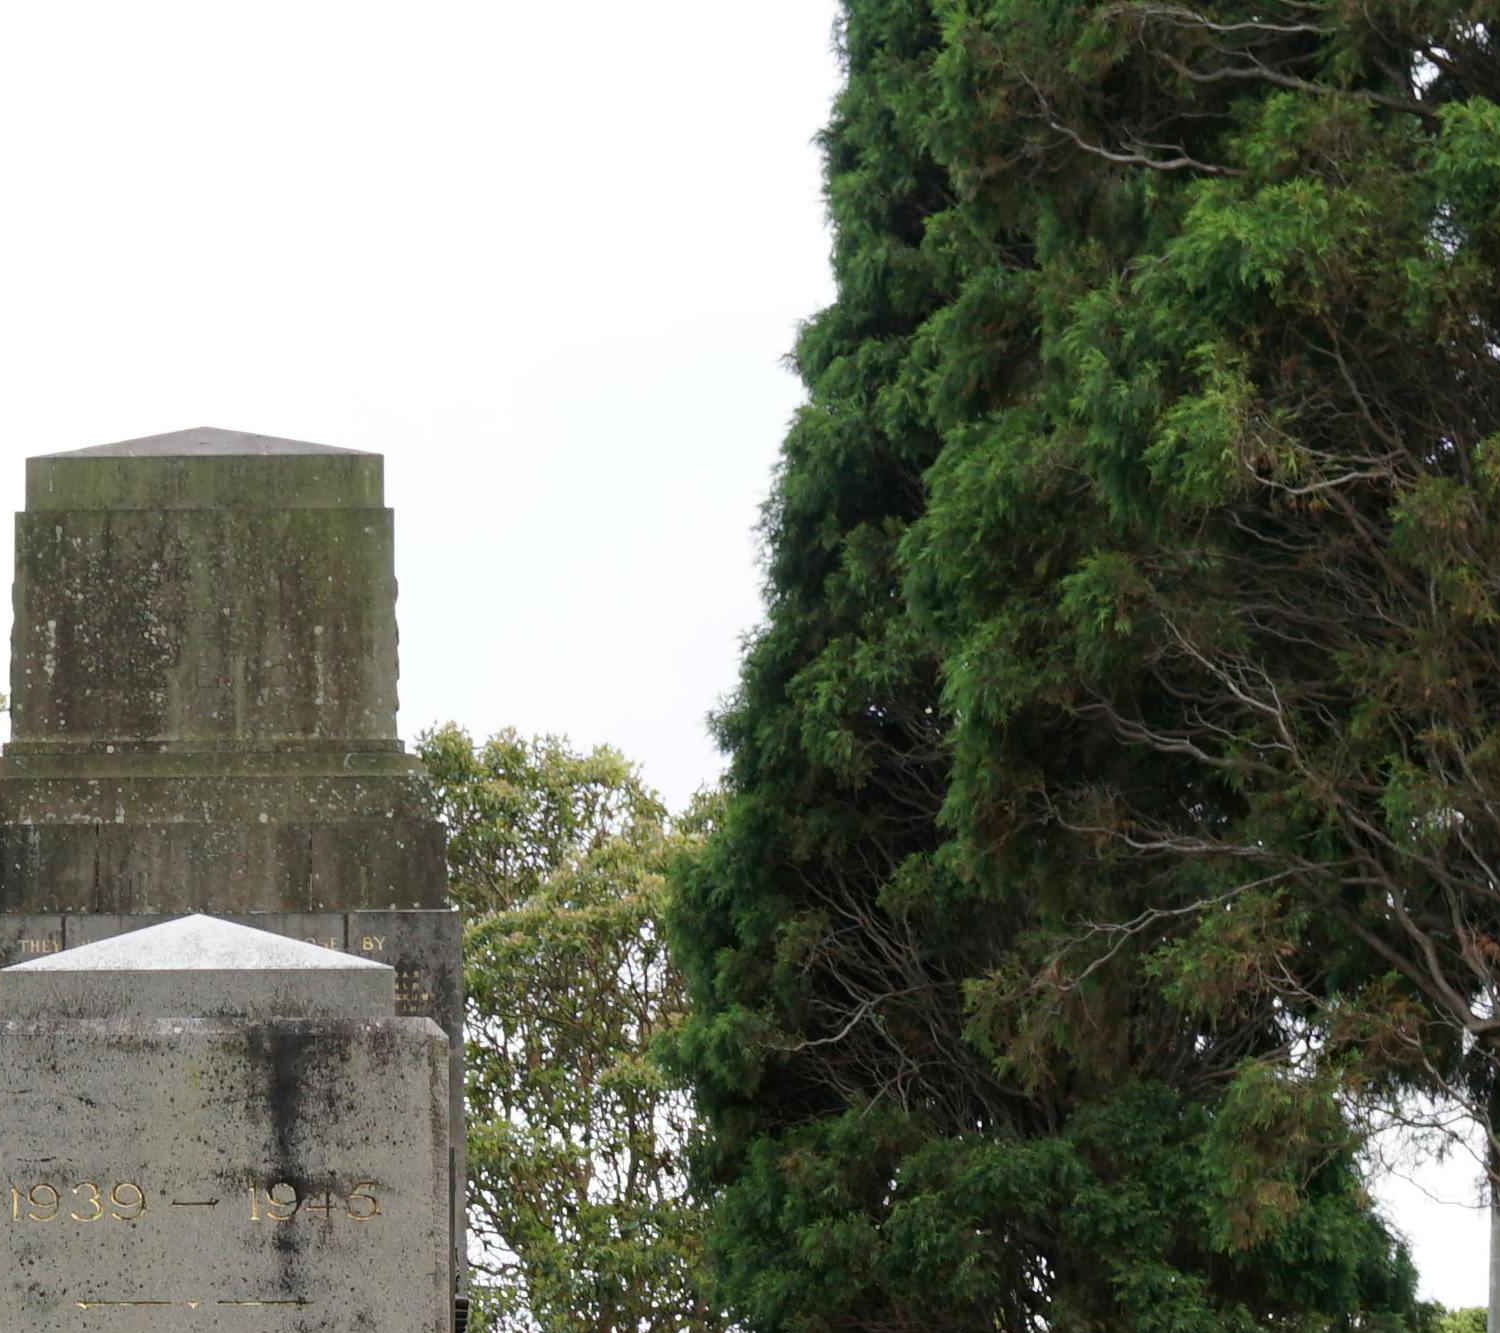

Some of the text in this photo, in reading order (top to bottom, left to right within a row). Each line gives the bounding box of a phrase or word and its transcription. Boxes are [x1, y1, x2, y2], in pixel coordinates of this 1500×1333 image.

[19, 936, 386, 952] THEY BY
[8, 1181, 148, 1223] 1939
[248, 1181, 382, 1223] 1945
